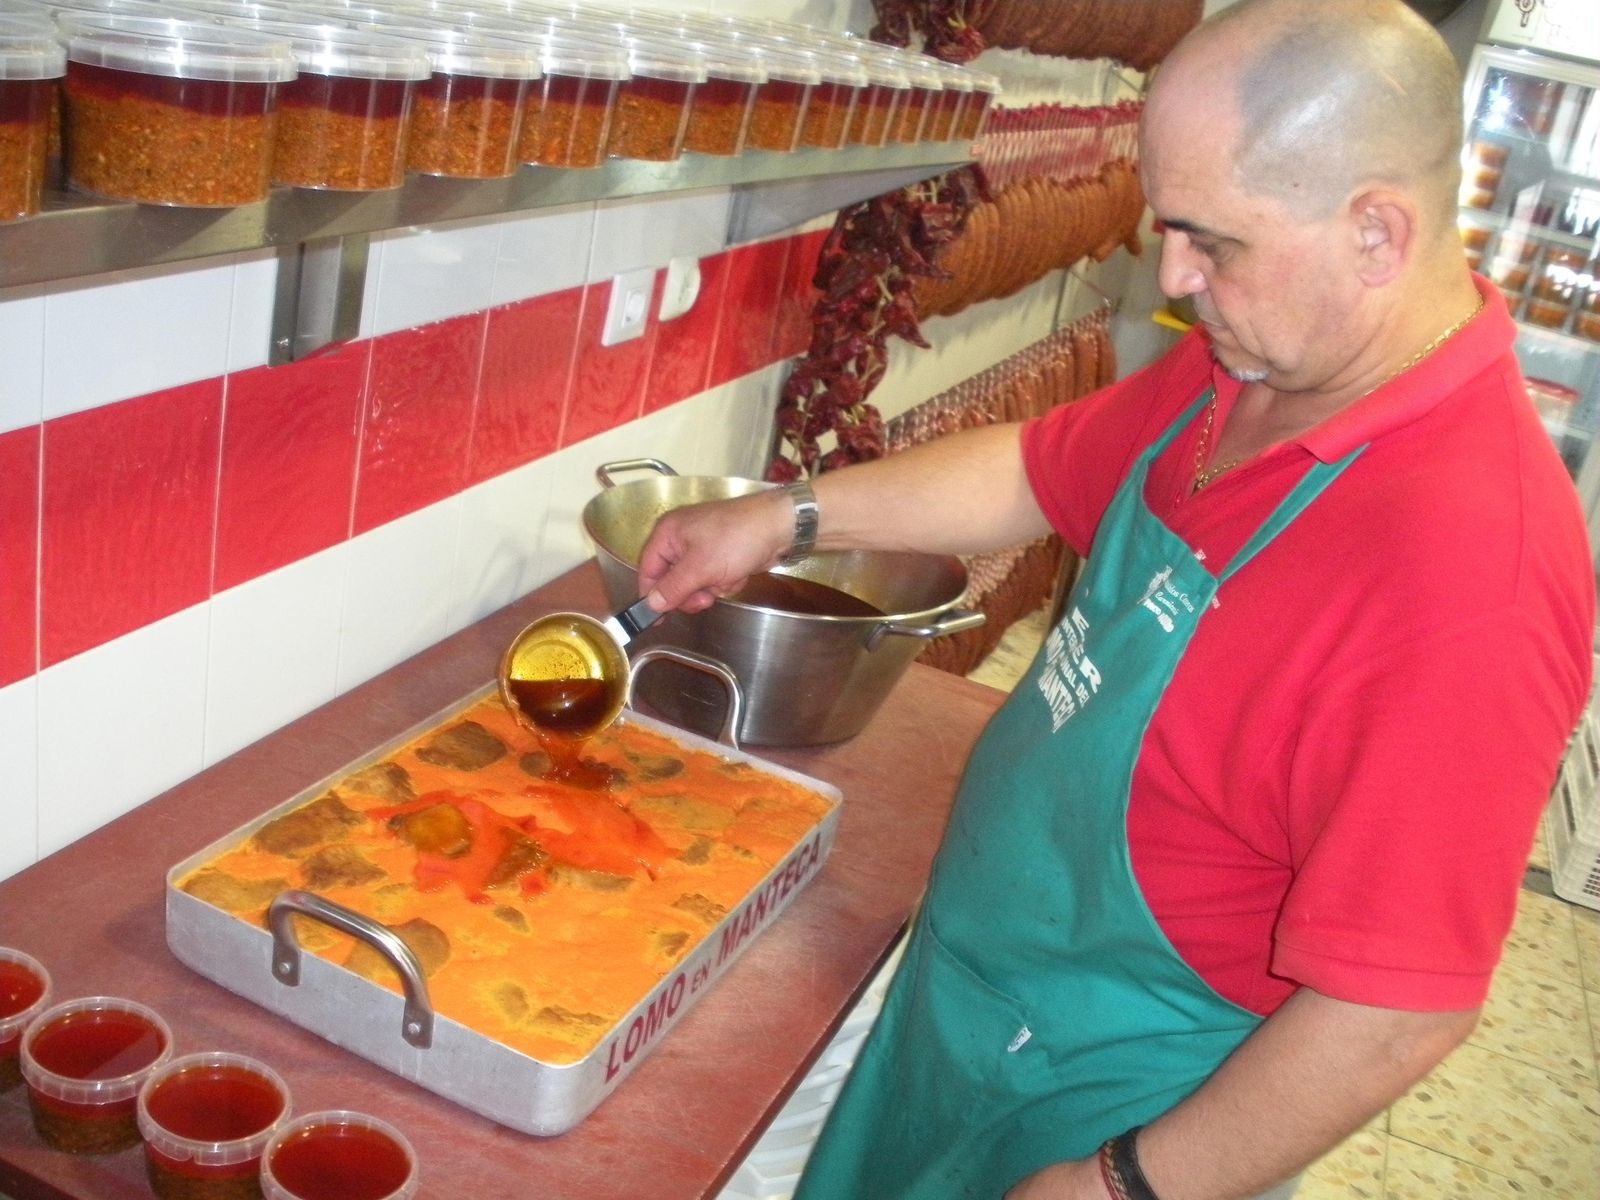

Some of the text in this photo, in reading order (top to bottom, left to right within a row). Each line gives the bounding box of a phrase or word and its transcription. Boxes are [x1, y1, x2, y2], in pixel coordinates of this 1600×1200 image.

[606, 832, 822, 1082] LOMO EN MANTECA
